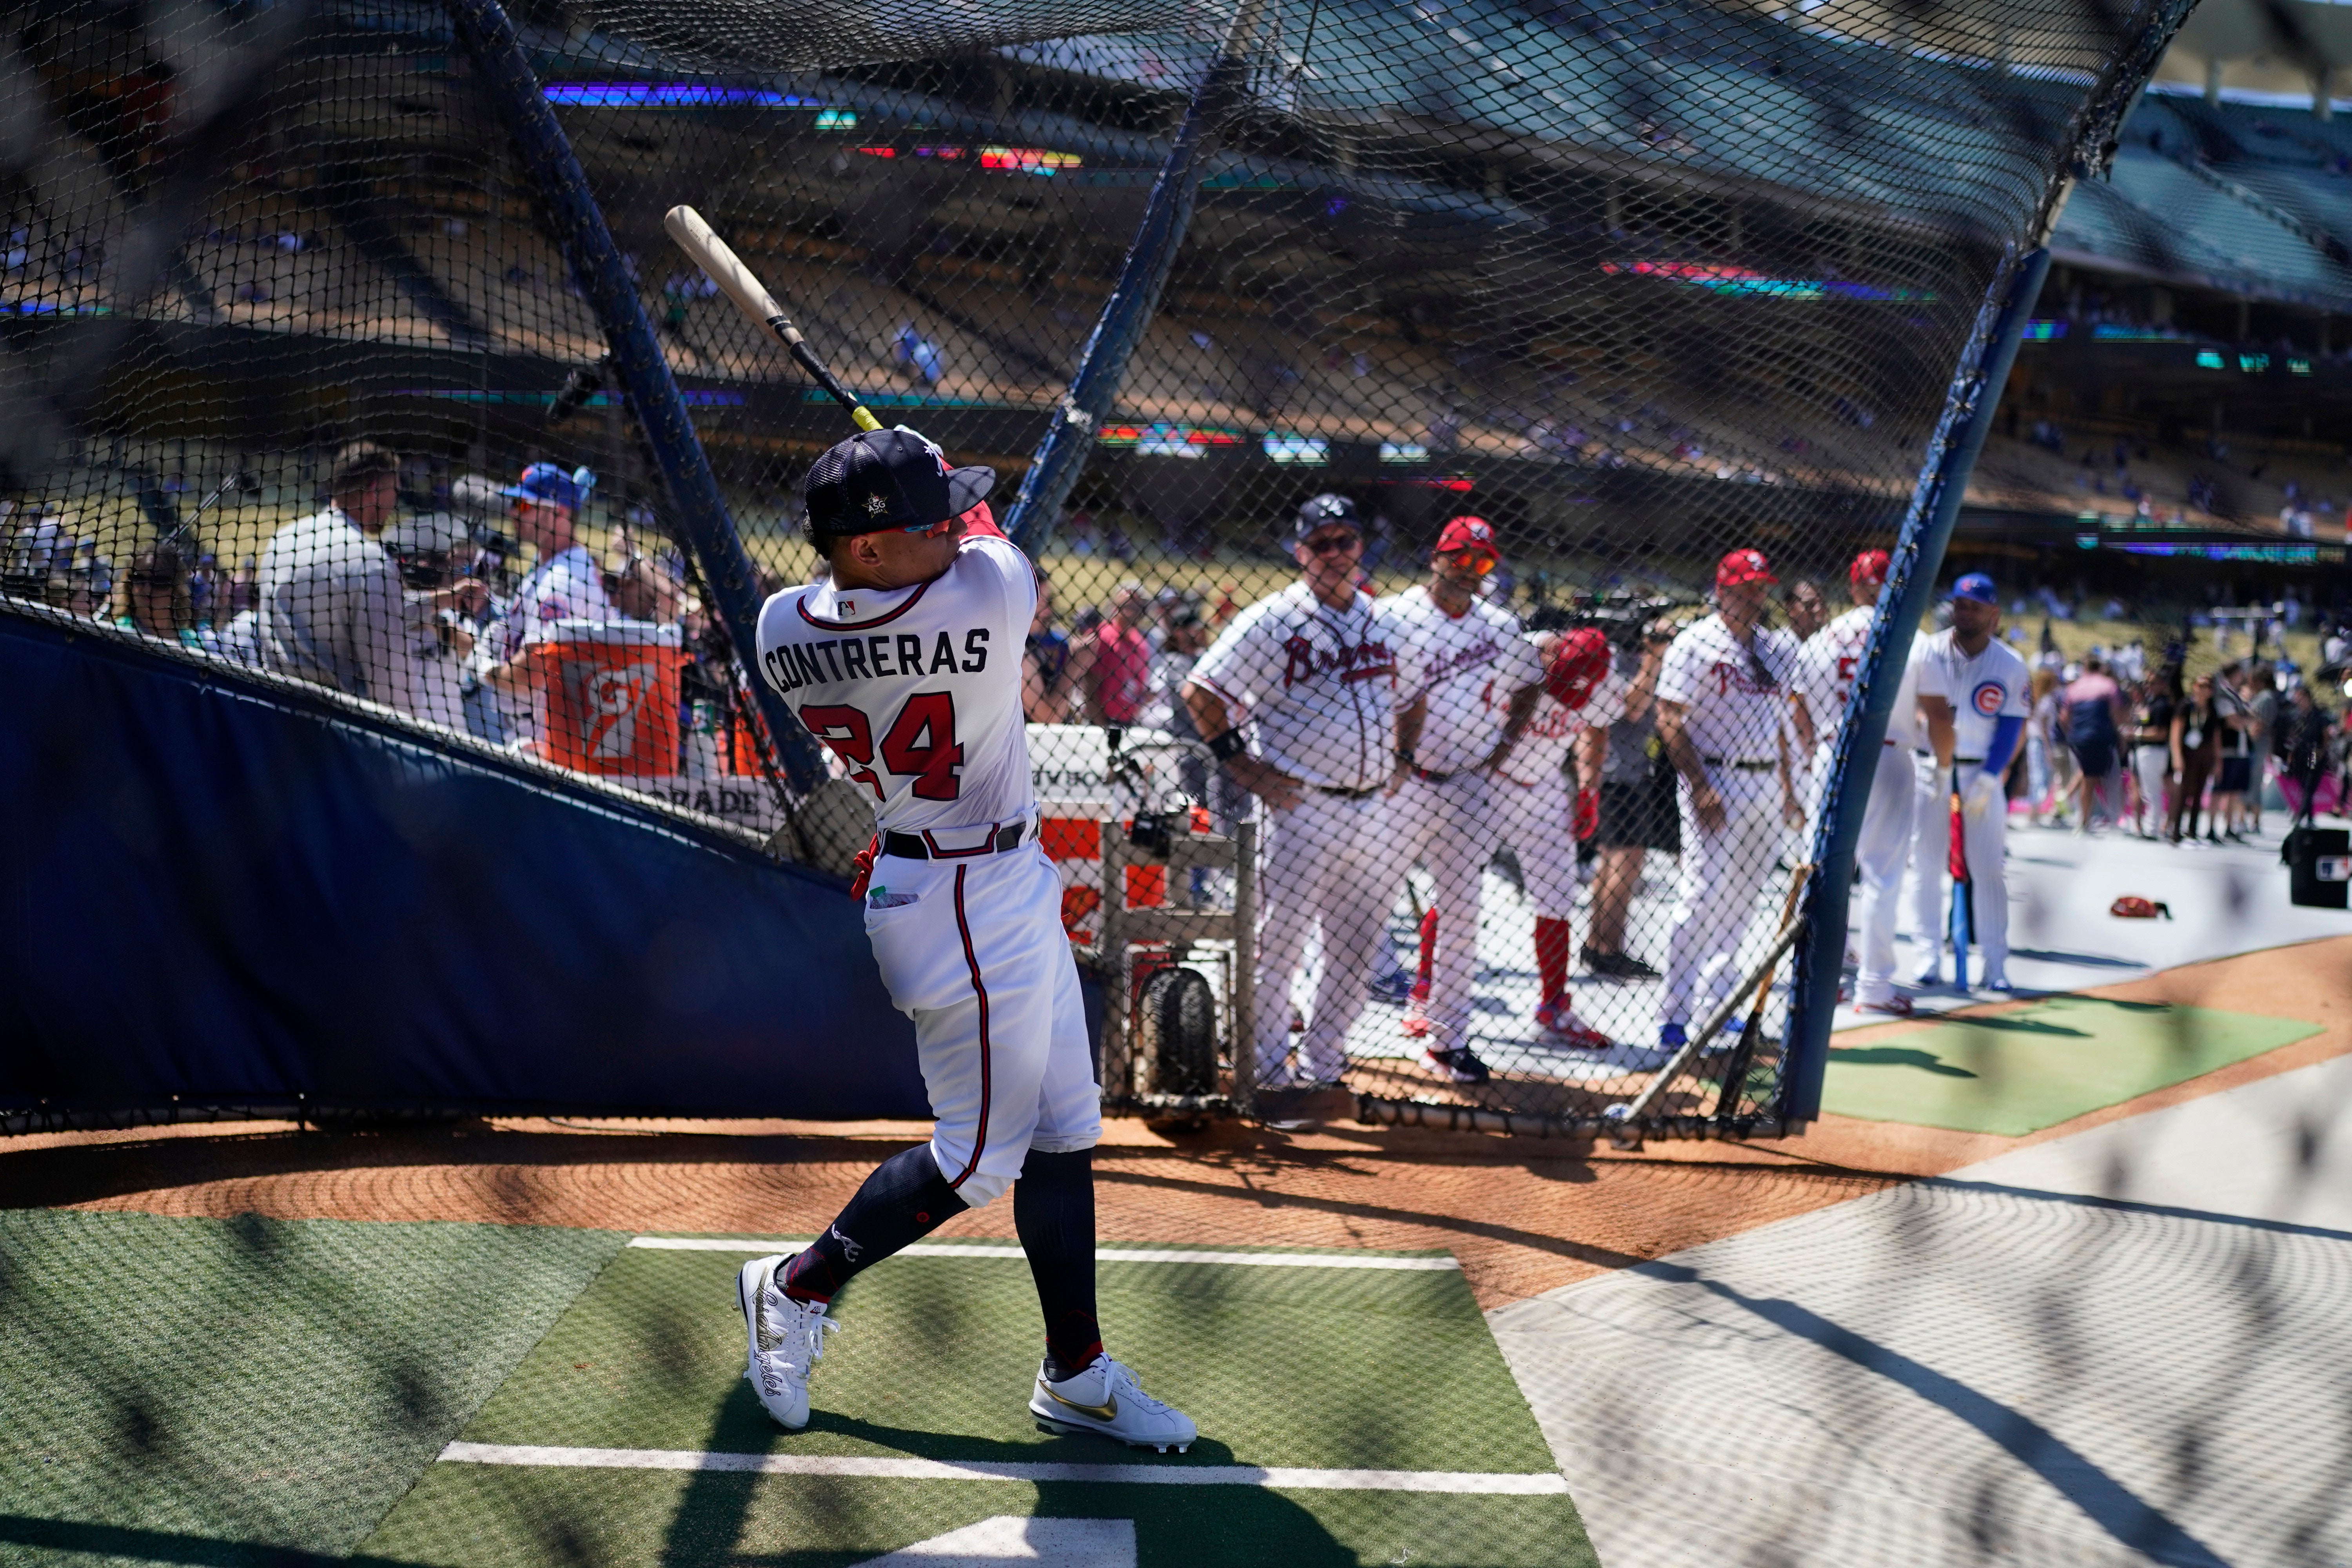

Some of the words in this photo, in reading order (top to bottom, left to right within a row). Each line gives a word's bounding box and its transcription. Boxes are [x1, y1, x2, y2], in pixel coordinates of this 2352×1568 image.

[868, 500, 886, 512] ASG
[765, 628, 989, 693] CONTRERAS
[799, 691, 964, 803] 24
[752, 1282, 778, 1313] Los
[753, 1315, 782, 1397] Angeles
